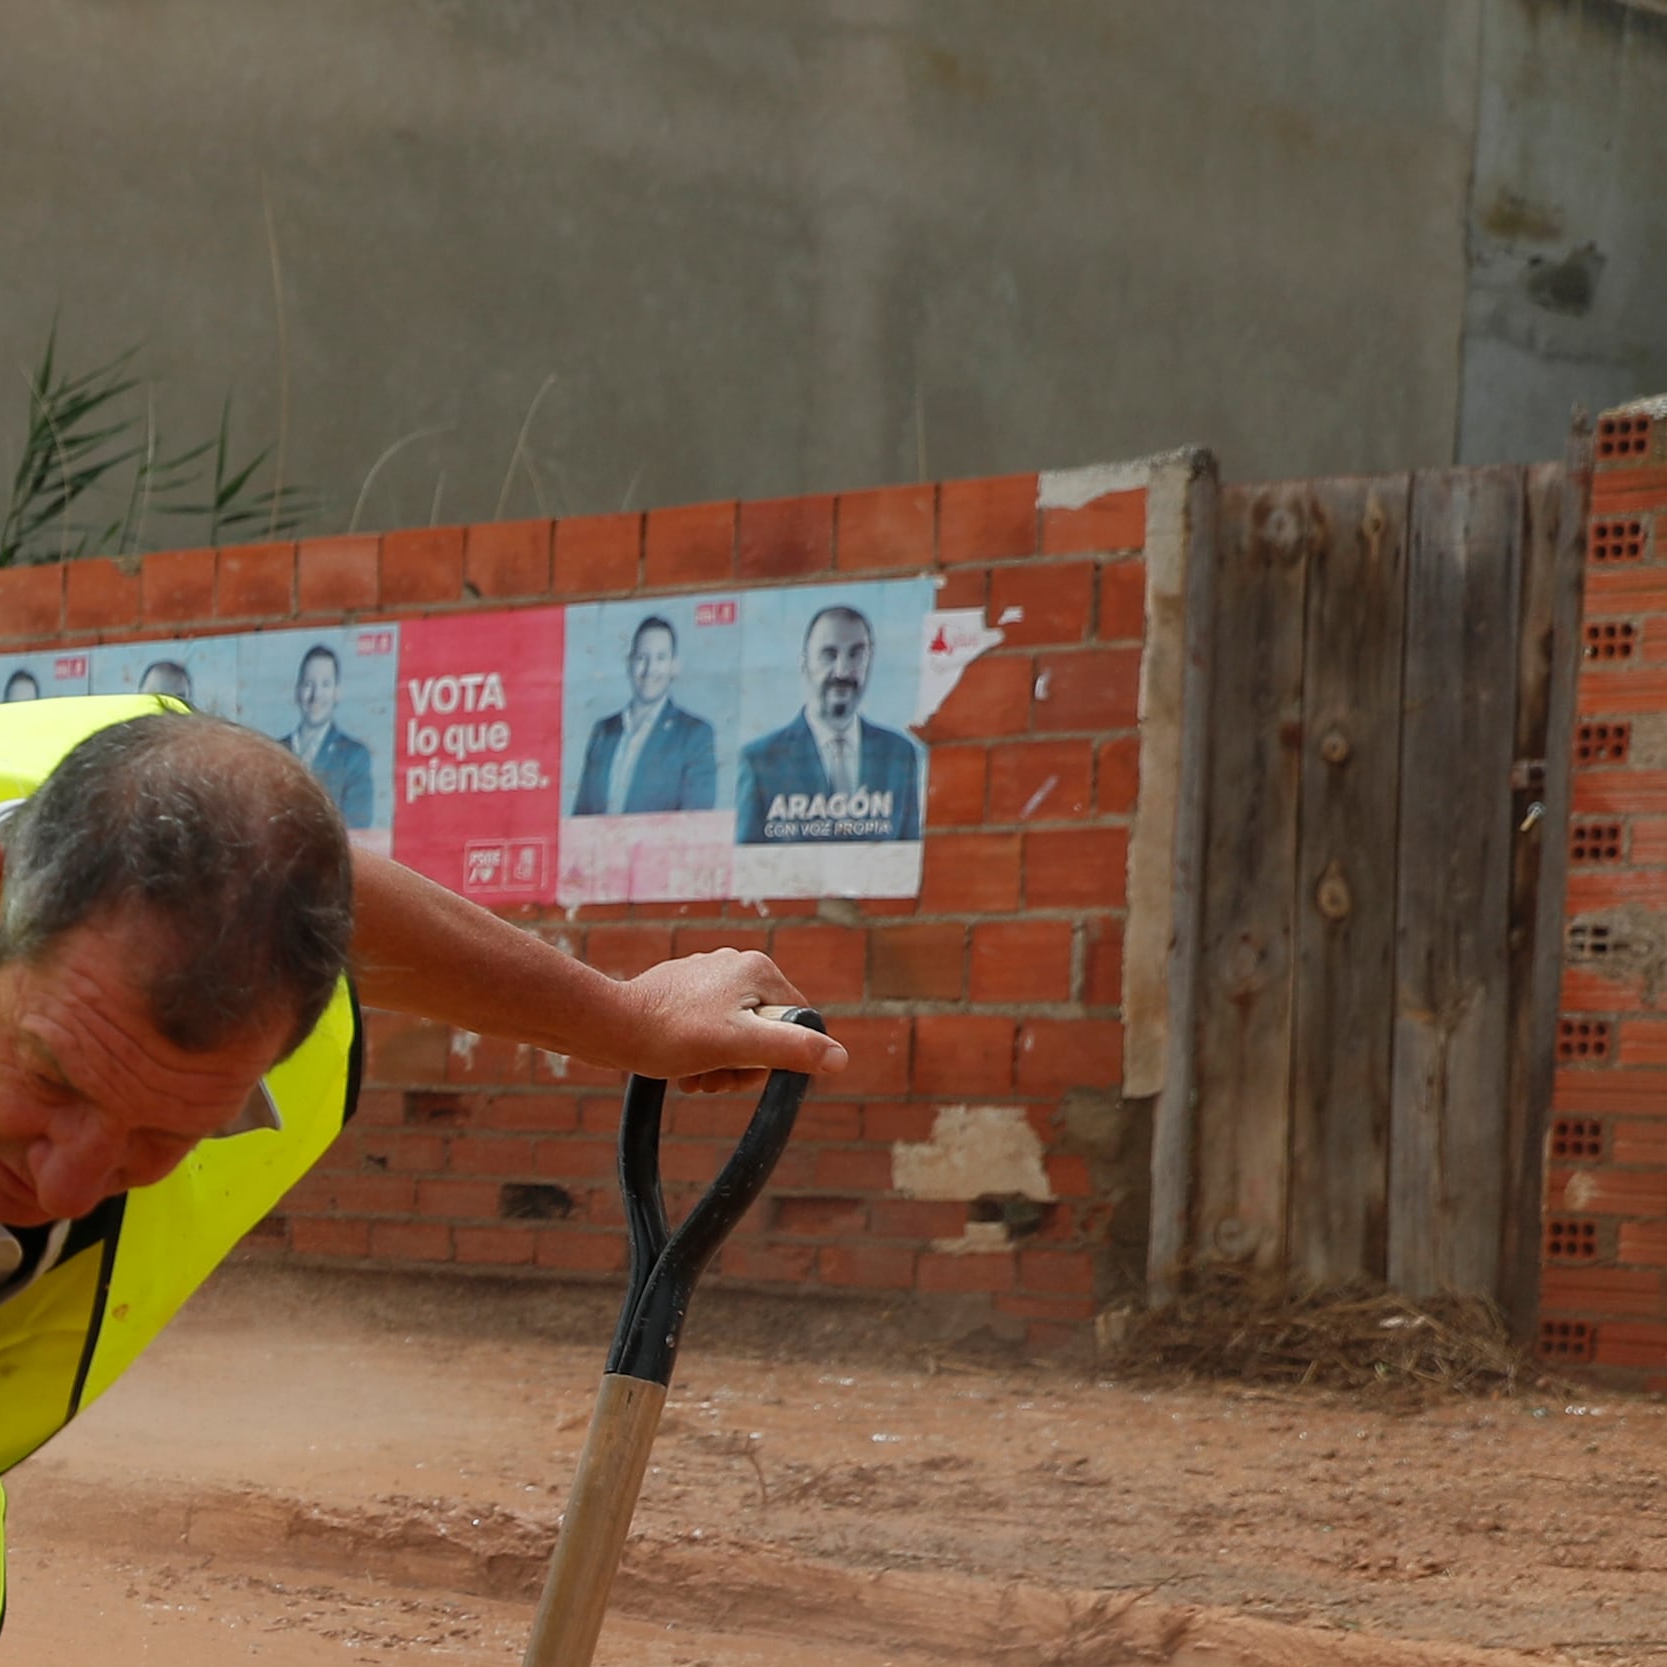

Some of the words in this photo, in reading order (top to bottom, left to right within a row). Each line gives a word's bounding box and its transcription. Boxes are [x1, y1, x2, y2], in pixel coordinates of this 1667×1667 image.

[408, 672, 506, 715] VOTA
[407, 717, 440, 756] lo
[443, 721, 511, 761] que
[405, 756, 550, 804] piensas.
[766, 784, 893, 821] ARAGÓN
[764, 822, 796, 837] CON
[834, 820, 890, 835] PROPIA
